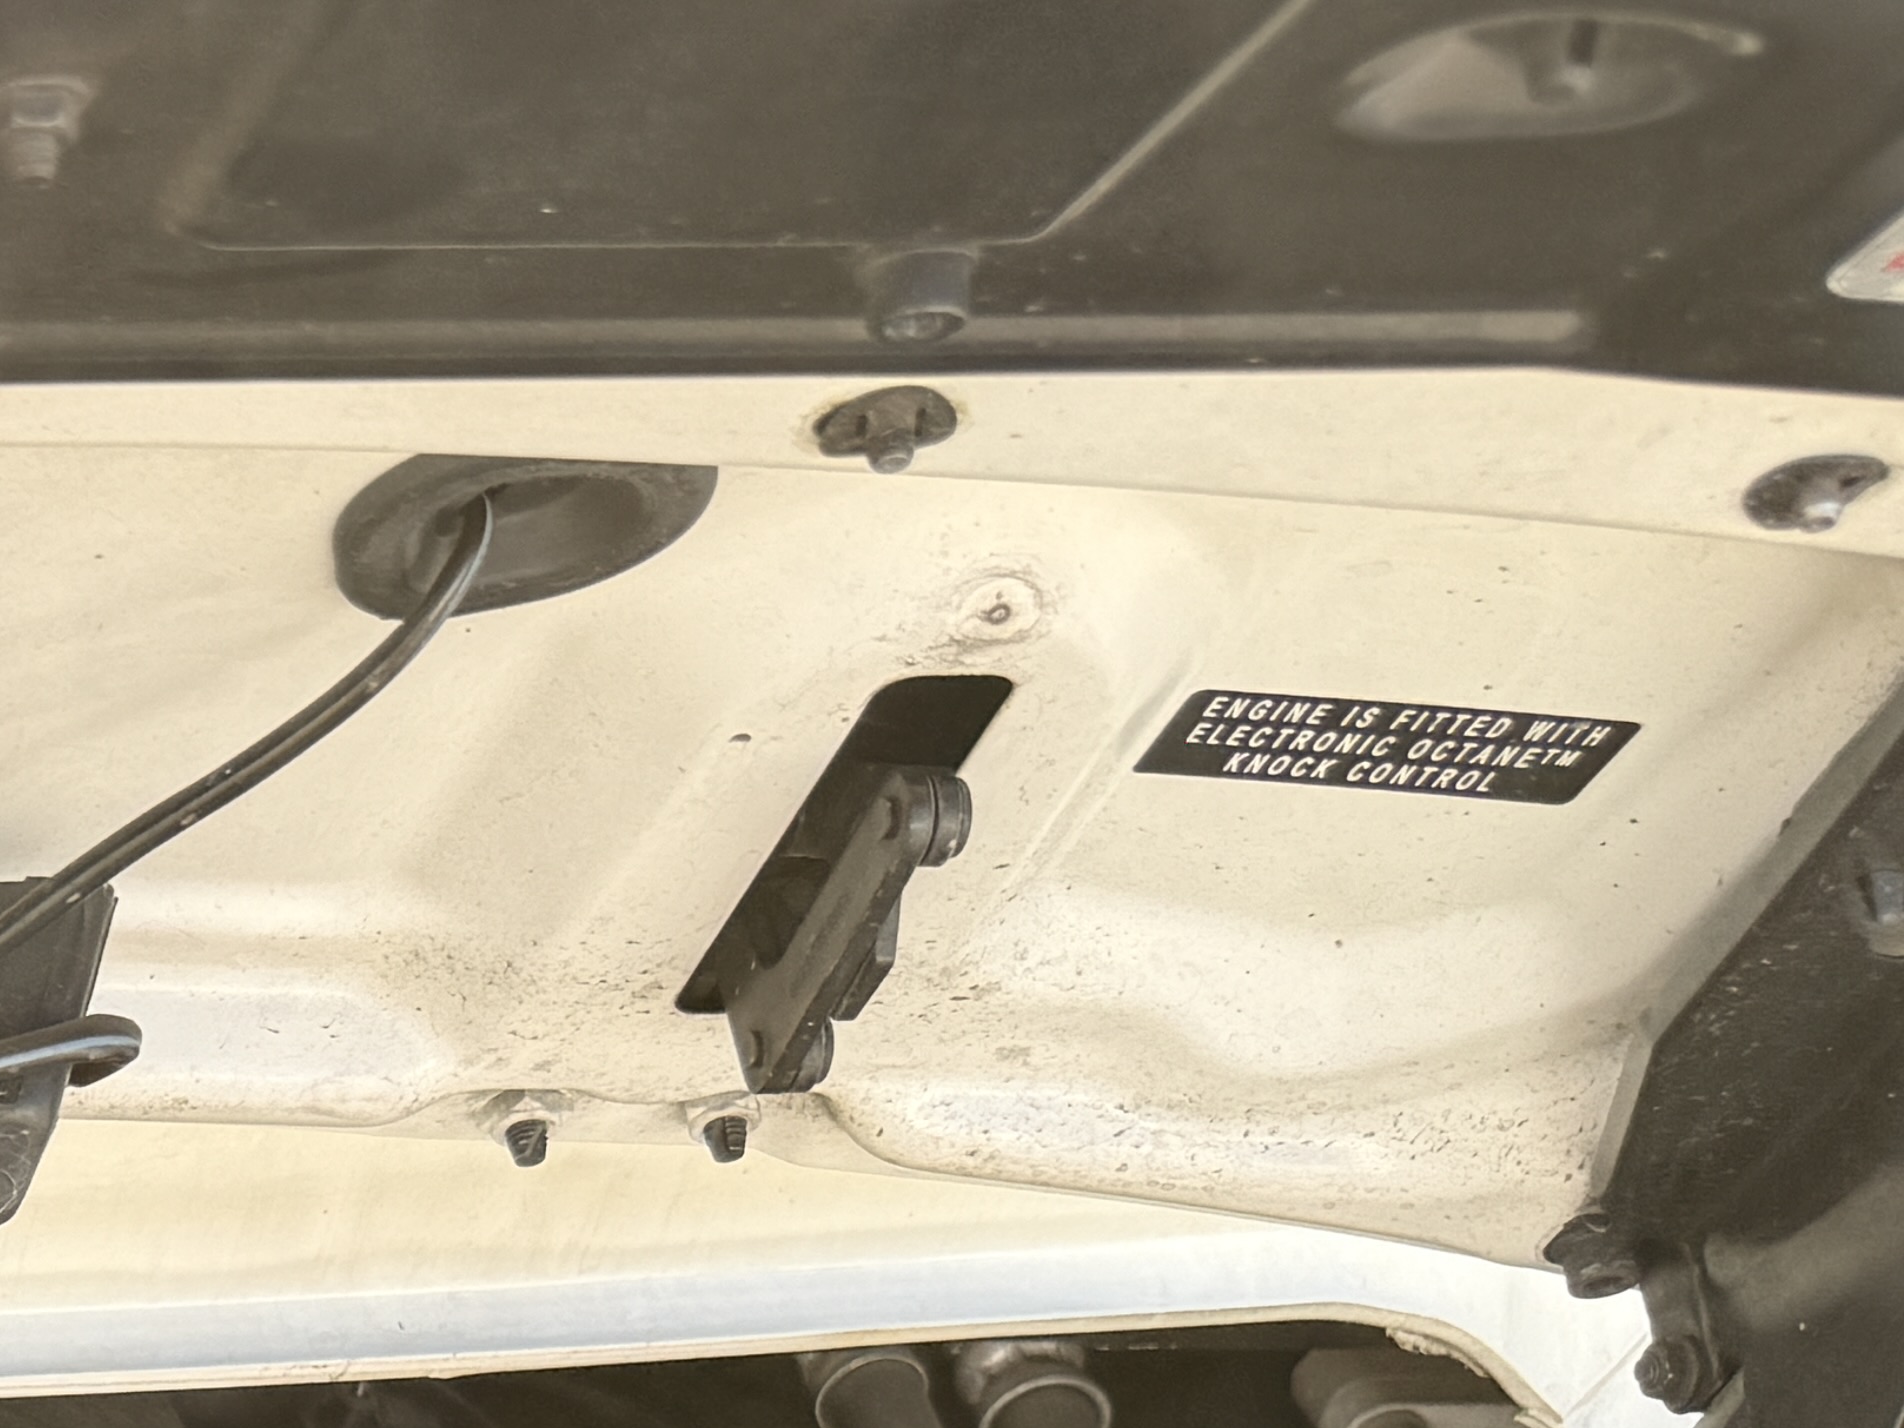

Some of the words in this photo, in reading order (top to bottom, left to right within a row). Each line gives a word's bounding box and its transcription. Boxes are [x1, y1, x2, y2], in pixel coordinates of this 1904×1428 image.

[1186, 722, 1398, 758] ELECTRONIC
[1202, 696, 1328, 726] ENGINE
[1340, 704, 1379, 730] IS
[1392, 708, 1511, 741] FITTED
[1523, 718, 1615, 748] WITH
[1223, 752, 1334, 780] KNOCK
[1345, 761, 1496, 794] CONTROL
